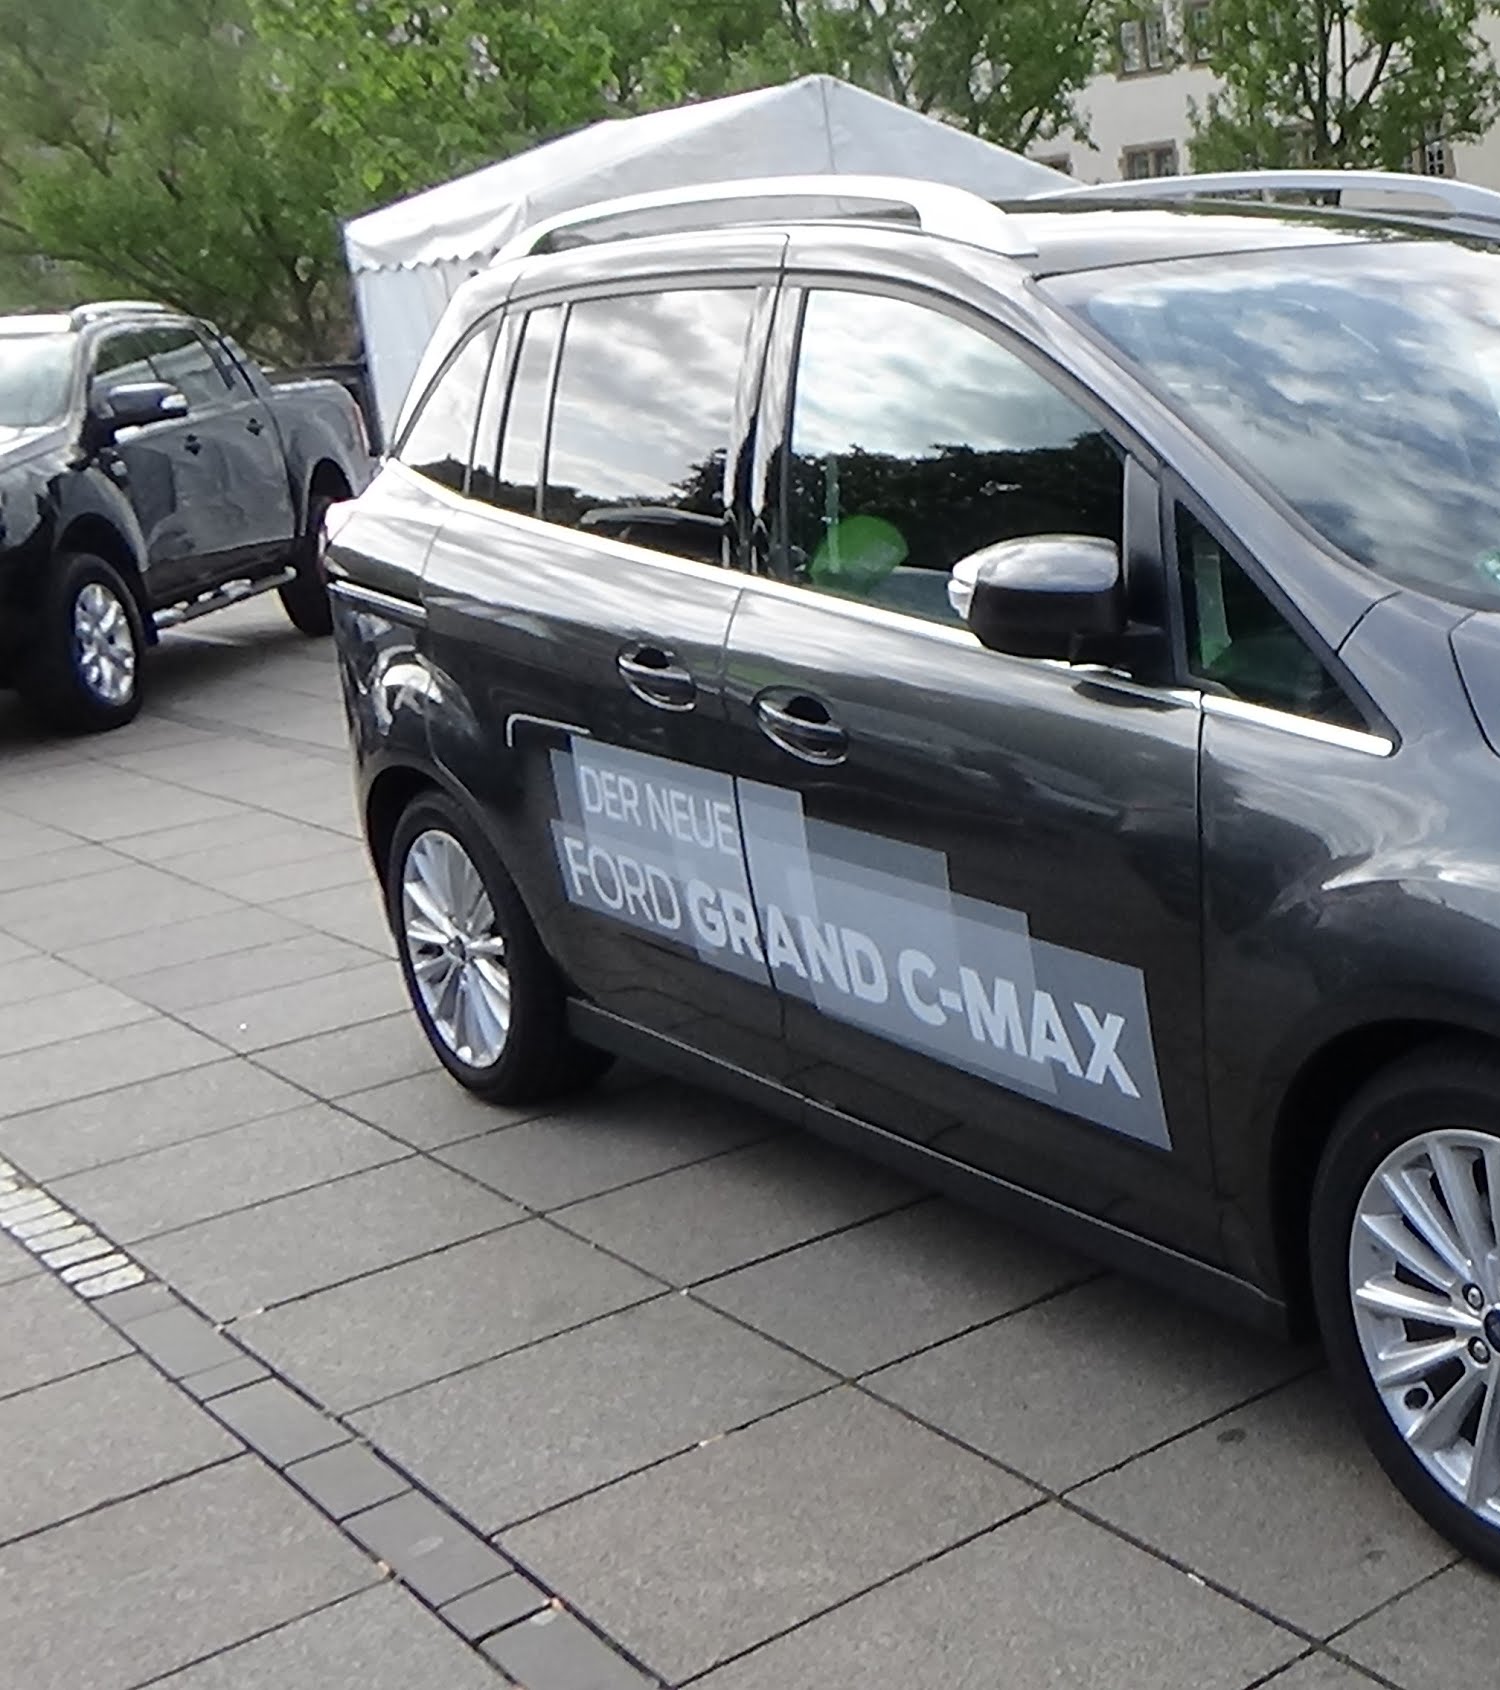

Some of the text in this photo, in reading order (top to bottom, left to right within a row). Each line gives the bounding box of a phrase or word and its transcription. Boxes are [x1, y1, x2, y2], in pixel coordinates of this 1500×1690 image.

[578, 764, 740, 857] DER NEUE
[562, 835, 1141, 1099] FORD GRAND C-MAX
